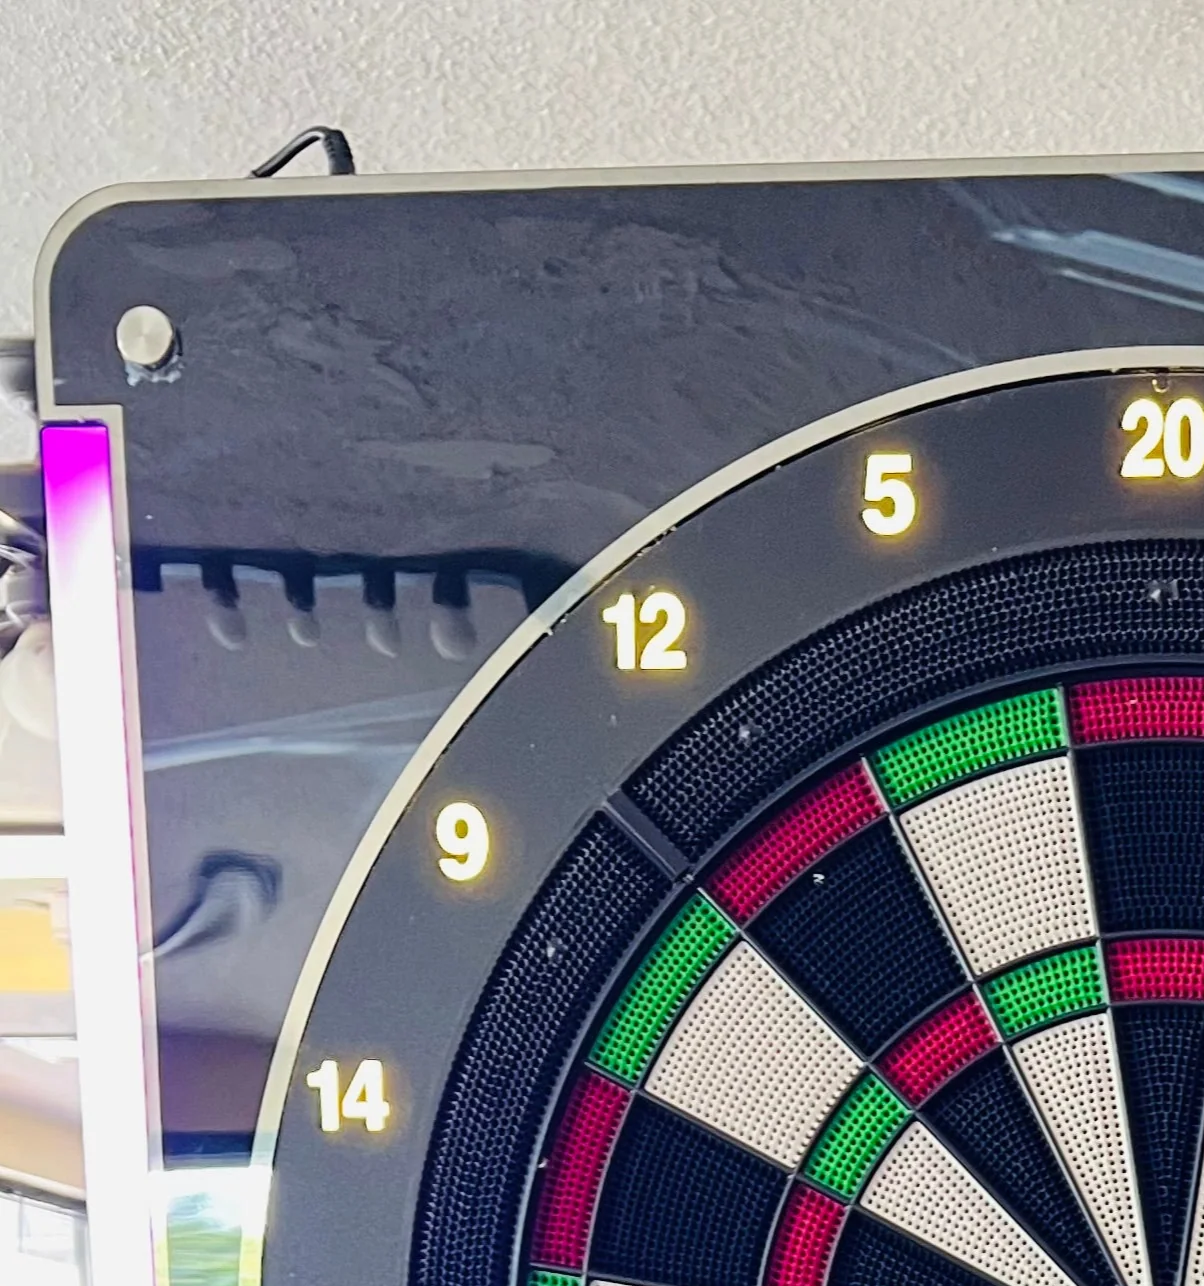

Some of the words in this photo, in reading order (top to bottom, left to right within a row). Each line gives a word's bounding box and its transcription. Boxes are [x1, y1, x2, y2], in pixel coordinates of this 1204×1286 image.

[861, 453, 917, 537] 5
[601, 590, 688, 671] 12
[435, 801, 491, 882] 9
[305, 1058, 391, 1133] 14
